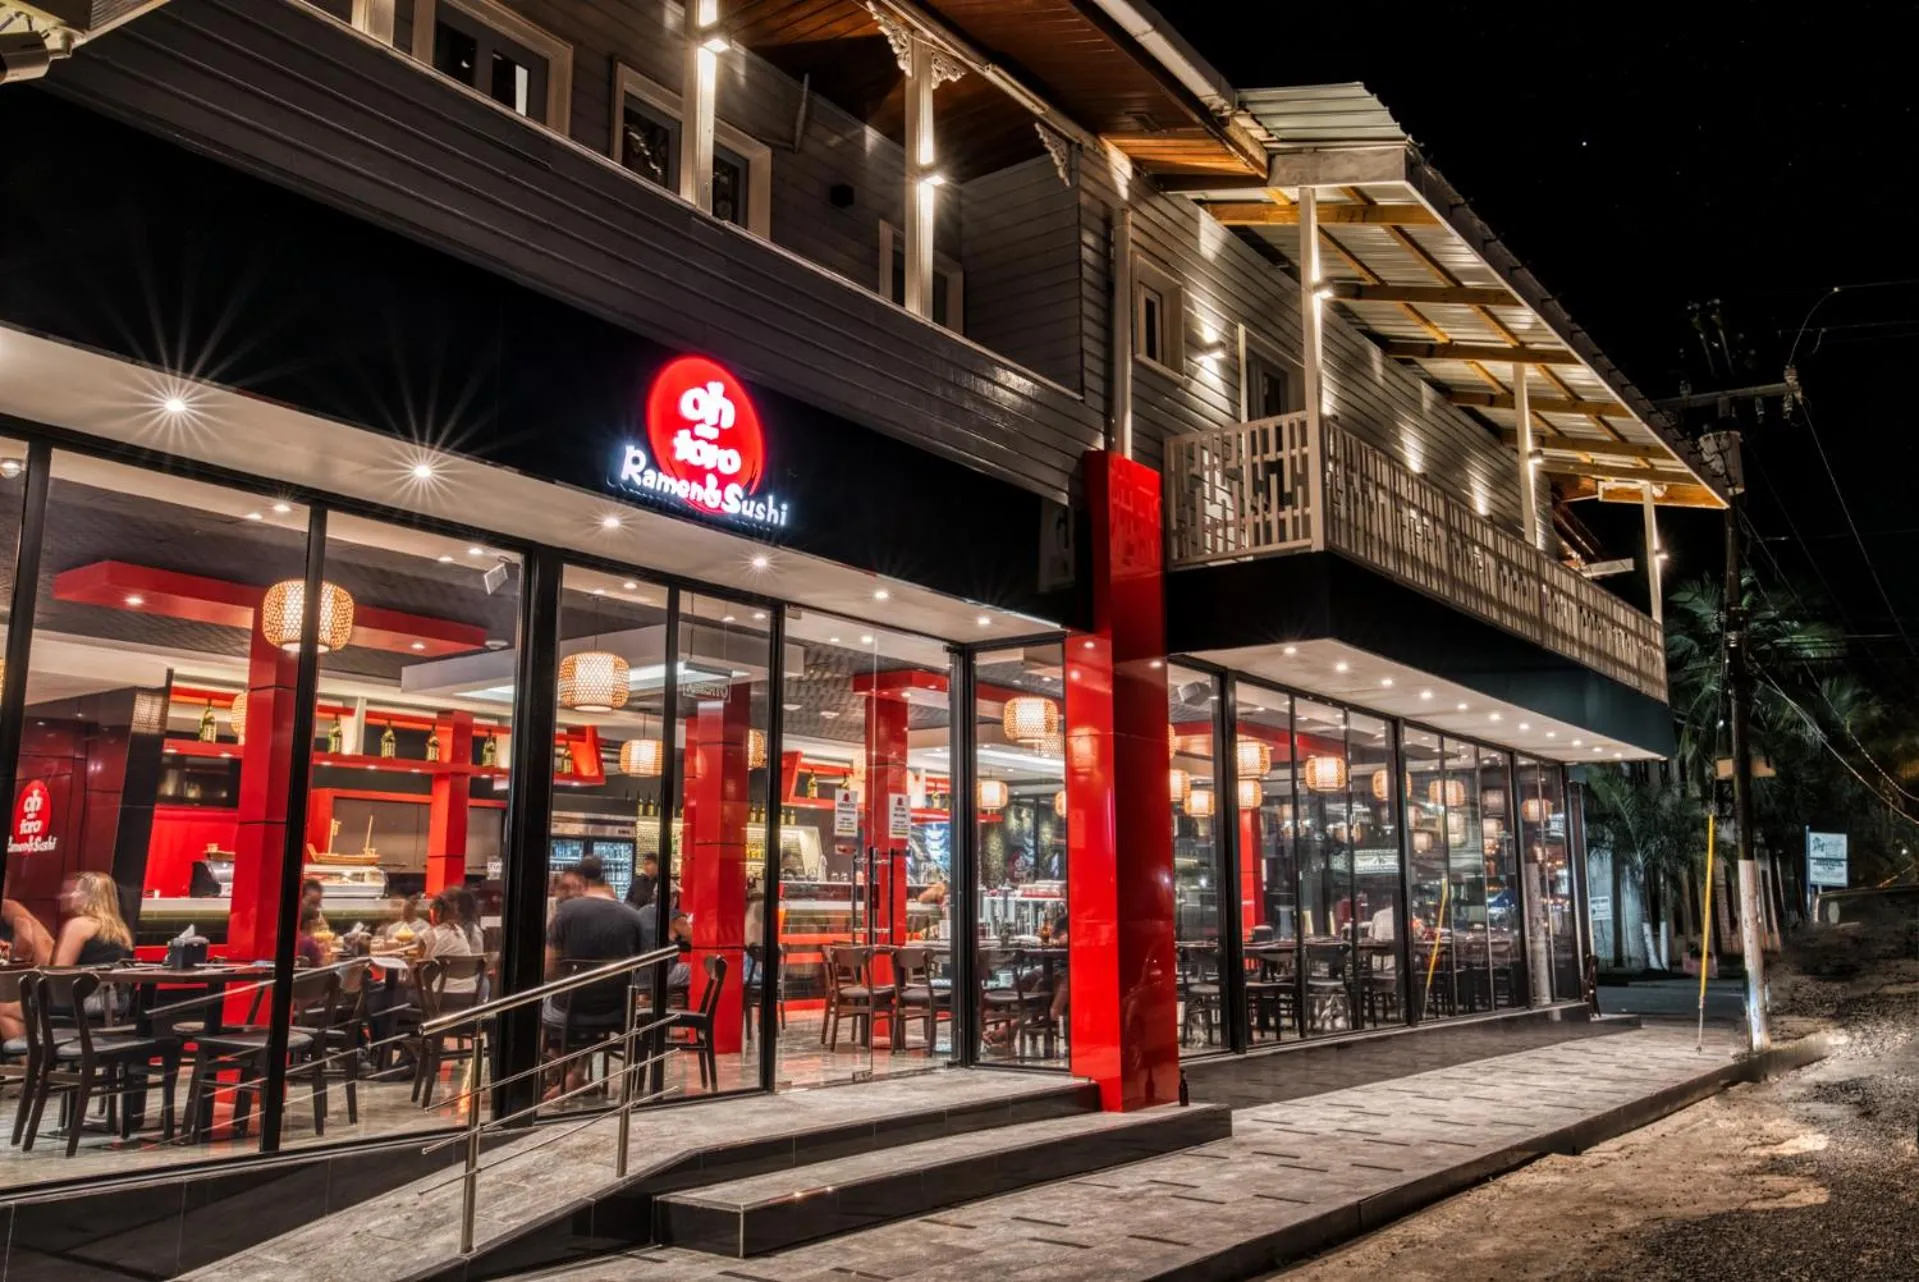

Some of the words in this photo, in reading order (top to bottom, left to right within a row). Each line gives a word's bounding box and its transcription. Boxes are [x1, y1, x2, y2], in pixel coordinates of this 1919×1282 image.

[679, 381, 736, 429] oh
[672, 428, 742, 475] toro
[23, 788, 43, 814] oh
